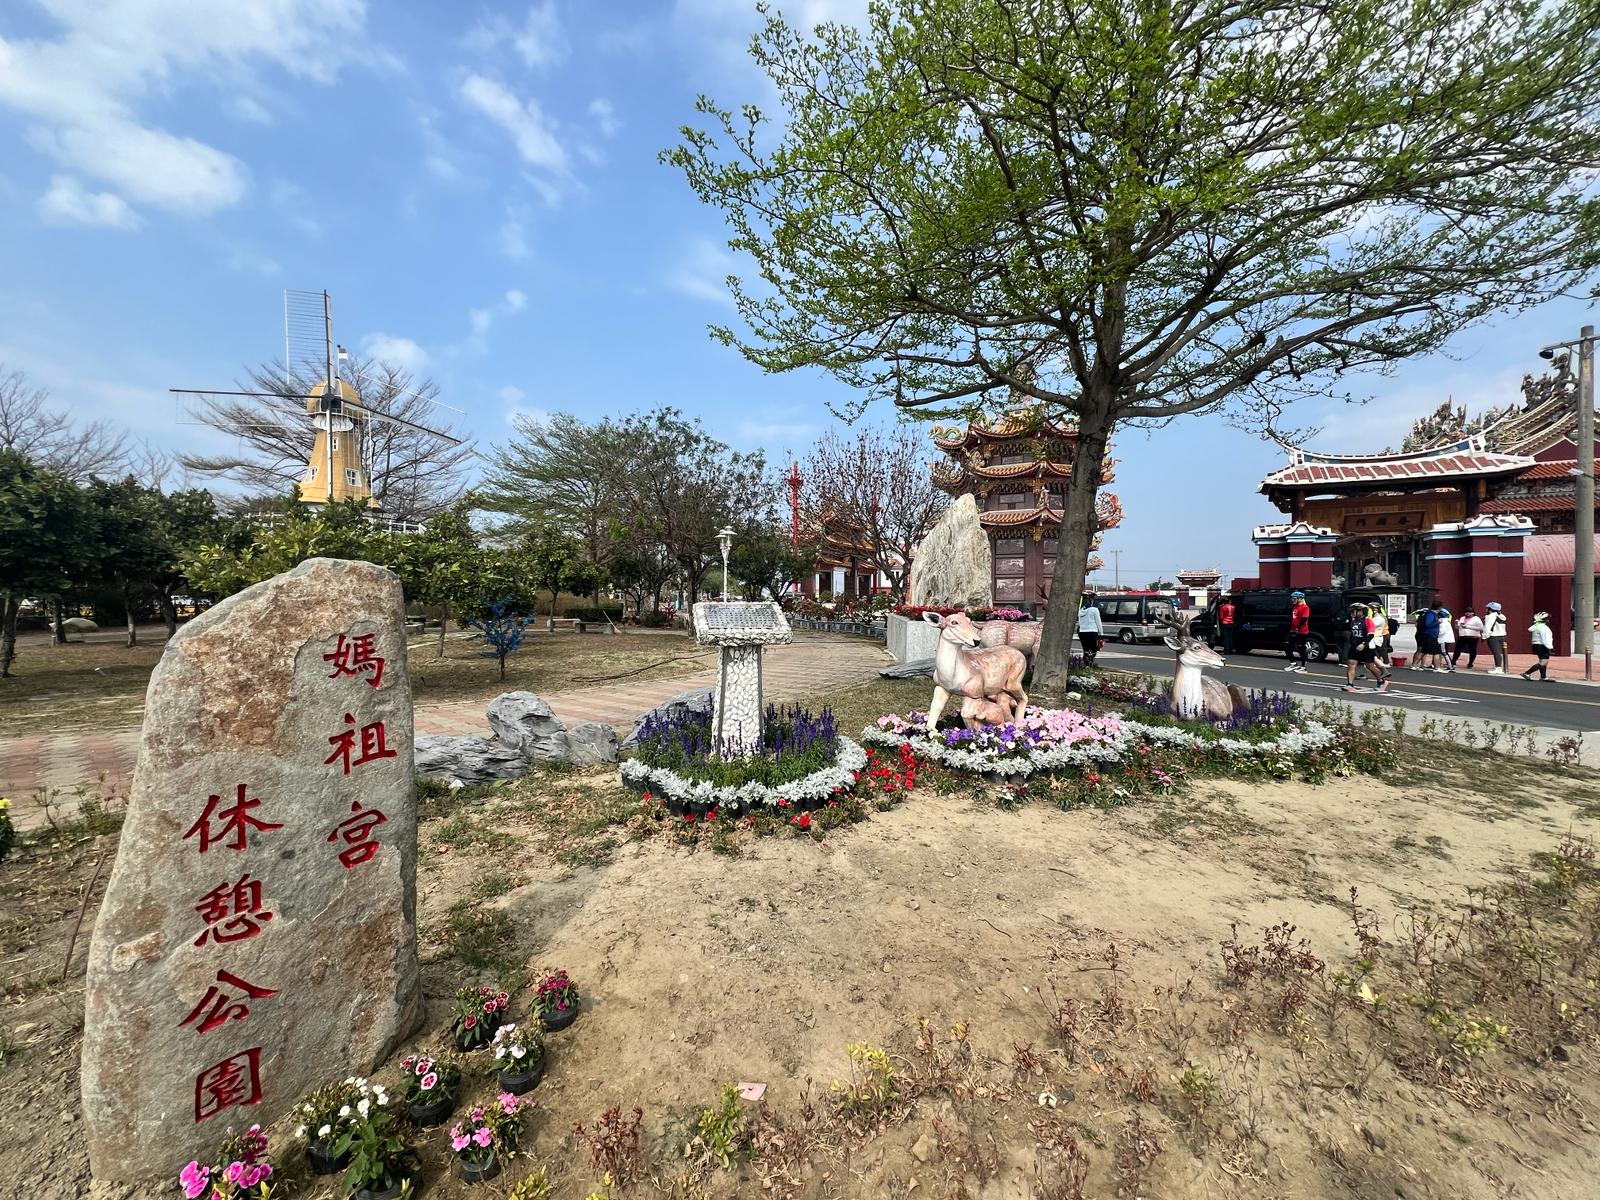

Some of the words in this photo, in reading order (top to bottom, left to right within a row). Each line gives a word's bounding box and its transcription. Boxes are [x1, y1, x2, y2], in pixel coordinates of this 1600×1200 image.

[323, 633, 397, 869] 媽祖宮
[178, 784, 284, 1123] 休憩公園
